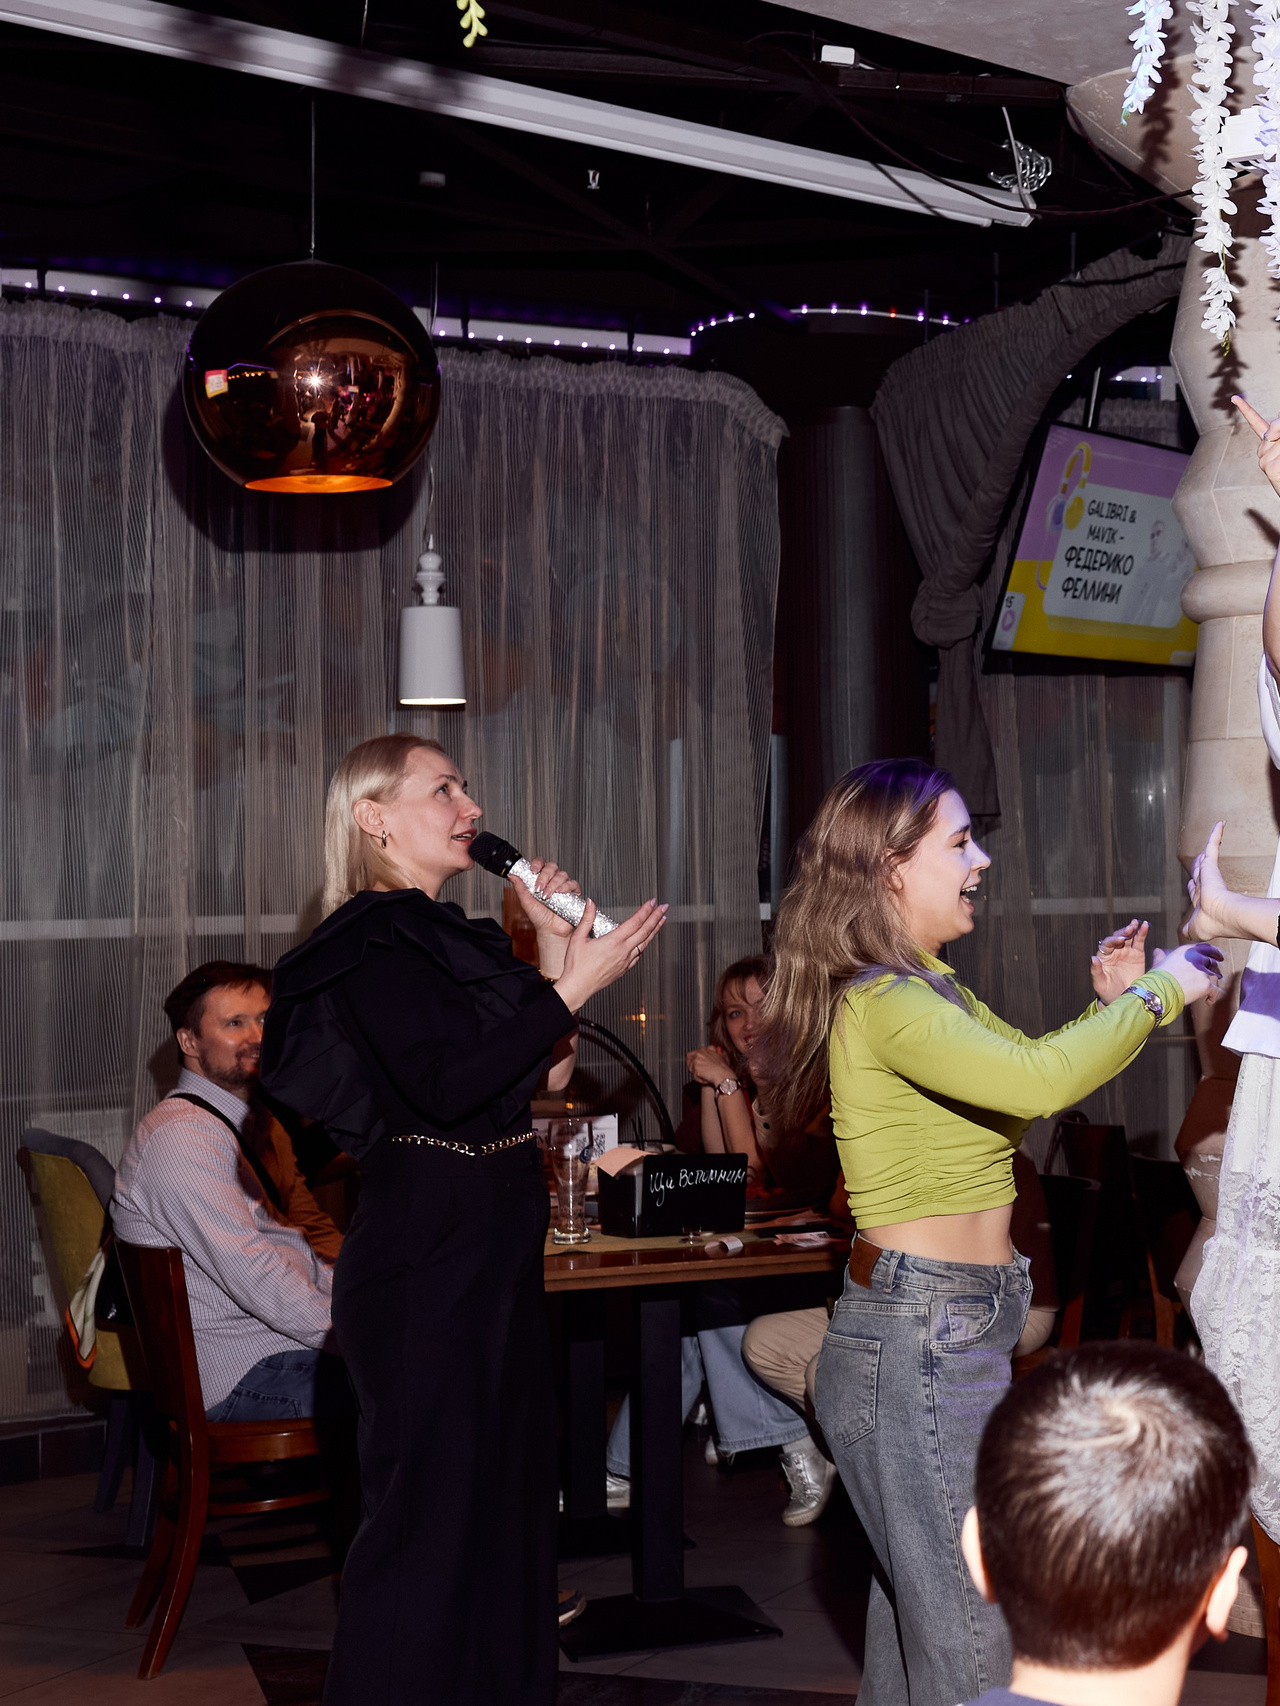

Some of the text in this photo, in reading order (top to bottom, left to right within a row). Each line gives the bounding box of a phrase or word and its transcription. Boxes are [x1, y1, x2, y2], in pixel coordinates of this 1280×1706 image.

[1087, 499, 1137, 523] GALIBRI &
[1086, 524, 1118, 544] MAVIK
[1064, 545, 1134, 576] ФЕДЕРИКО
[1061, 576, 1123, 604] ФЕЛЛИНИ
[650, 1172, 675, 1207] Ща
